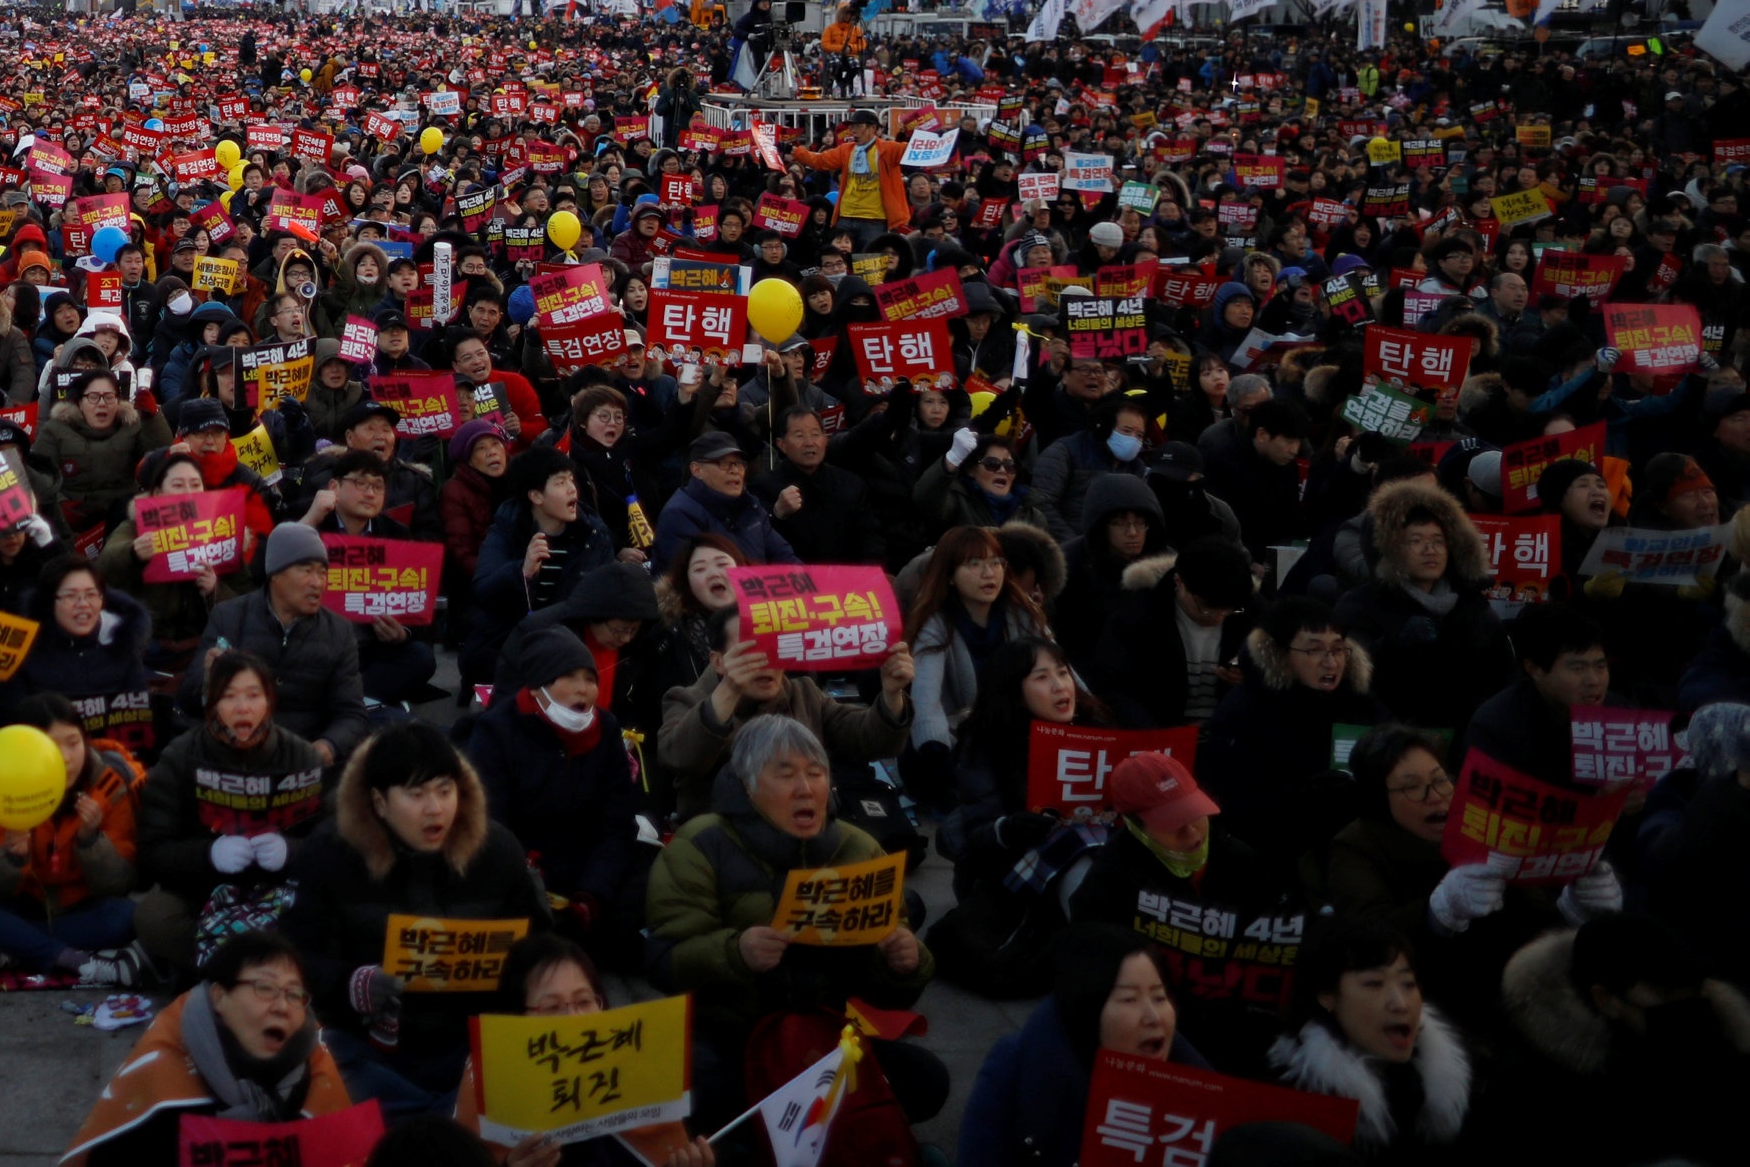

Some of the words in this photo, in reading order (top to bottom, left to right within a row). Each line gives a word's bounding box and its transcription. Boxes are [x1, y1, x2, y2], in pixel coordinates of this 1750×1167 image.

[173, 99, 192, 110] 탄핵
[335, 92, 355, 103] 탄핵
[496, 98, 520, 110] 탄핵
[223, 103, 245, 118] 탄핵
[533, 107, 555, 120] 탄핵
[164, 120, 195, 133] 특검연장
[249, 132, 281, 143] 특검연장
[367, 116, 392, 137] 탄핵
[124, 130, 160, 148] 특검연장
[298, 135, 326, 148] 박근혜를
[296, 145, 325, 156] 구속하라
[177, 158, 219, 177] 특검연장
[1069, 167, 1112, 180] 특검연장
[82, 205, 125, 224] 퇴진·구속!
[272, 204, 318, 220] 퇴진·구속!
[759, 205, 802, 224] 퇴진·구속!
[505, 228, 529, 239] 박근혜
[531, 228, 544, 238] 4년
[196, 262, 236, 276] 세월호참사
[669, 269, 718, 287] 박근혜
[1543, 268, 1615, 285] 퇴진·구속!
[199, 274, 231, 289] 진상규명
[533, 275, 568, 297] 박근혜
[880, 281, 919, 302] 박근혜
[1164, 279, 1217, 301] 탄핵
[537, 281, 600, 313] 퇴진·구속!
[884, 284, 955, 321] 퇴진·구속!
[1068, 300, 1113, 317] 박근혜
[1116, 297, 1144, 315] 4년
[550, 295, 605, 325] 특검연장
[1609, 309, 1658, 328] 박근혜
[663, 304, 732, 346] 탄핵
[1068, 317, 1112, 331] 너희들의
[1114, 315, 1146, 329] 세상은
[547, 329, 624, 359] 특검연장
[1070, 328, 1148, 359] 끝났다
[1615, 324, 1695, 351] 퇴진·구속!
[241, 347, 284, 368] 박근혜
[287, 340, 308, 359] 4년
[863, 332, 935, 373] 탄핵
[1379, 340, 1453, 383] 탄핵
[1634, 346, 1699, 368] 특검연장
[265, 364, 310, 385] 박근혜를
[141, 501, 197, 527] 박근혜
[152, 514, 236, 554] 퇴진·구속!
[166, 539, 237, 573] 특검연장
[328, 544, 386, 566] 박근혜
[327, 567, 427, 592] 퇴진·구속!
[738, 570, 818, 598] 박근혜
[344, 590, 428, 617] 특검연장
[750, 591, 881, 635] 퇴진·구속!
[777, 621, 888, 662] 특검연장
[1066, 731, 1117, 743] www.nanum.com
[1570, 721, 1669, 752] 박근혜
[196, 770, 272, 795] 박근혜
[276, 768, 322, 792] 4년
[1471, 769, 1578, 827] 박근혜
[795, 865, 897, 906] 박근혜를
[786, 901, 893, 934] 구속하라
[1137, 889, 1238, 940] 박근혜
[1243, 913, 1305, 944] 4년
[399, 926, 515, 954] 박근혜를
[1133, 915, 1226, 959] 너희들의
[527, 1019, 643, 1073] 박근혜
[1104, 1057, 1146, 1074] 나눔문화
[1148, 1070, 1224, 1093] www.nanum.com
[551, 1067, 623, 1115] 퇴진
